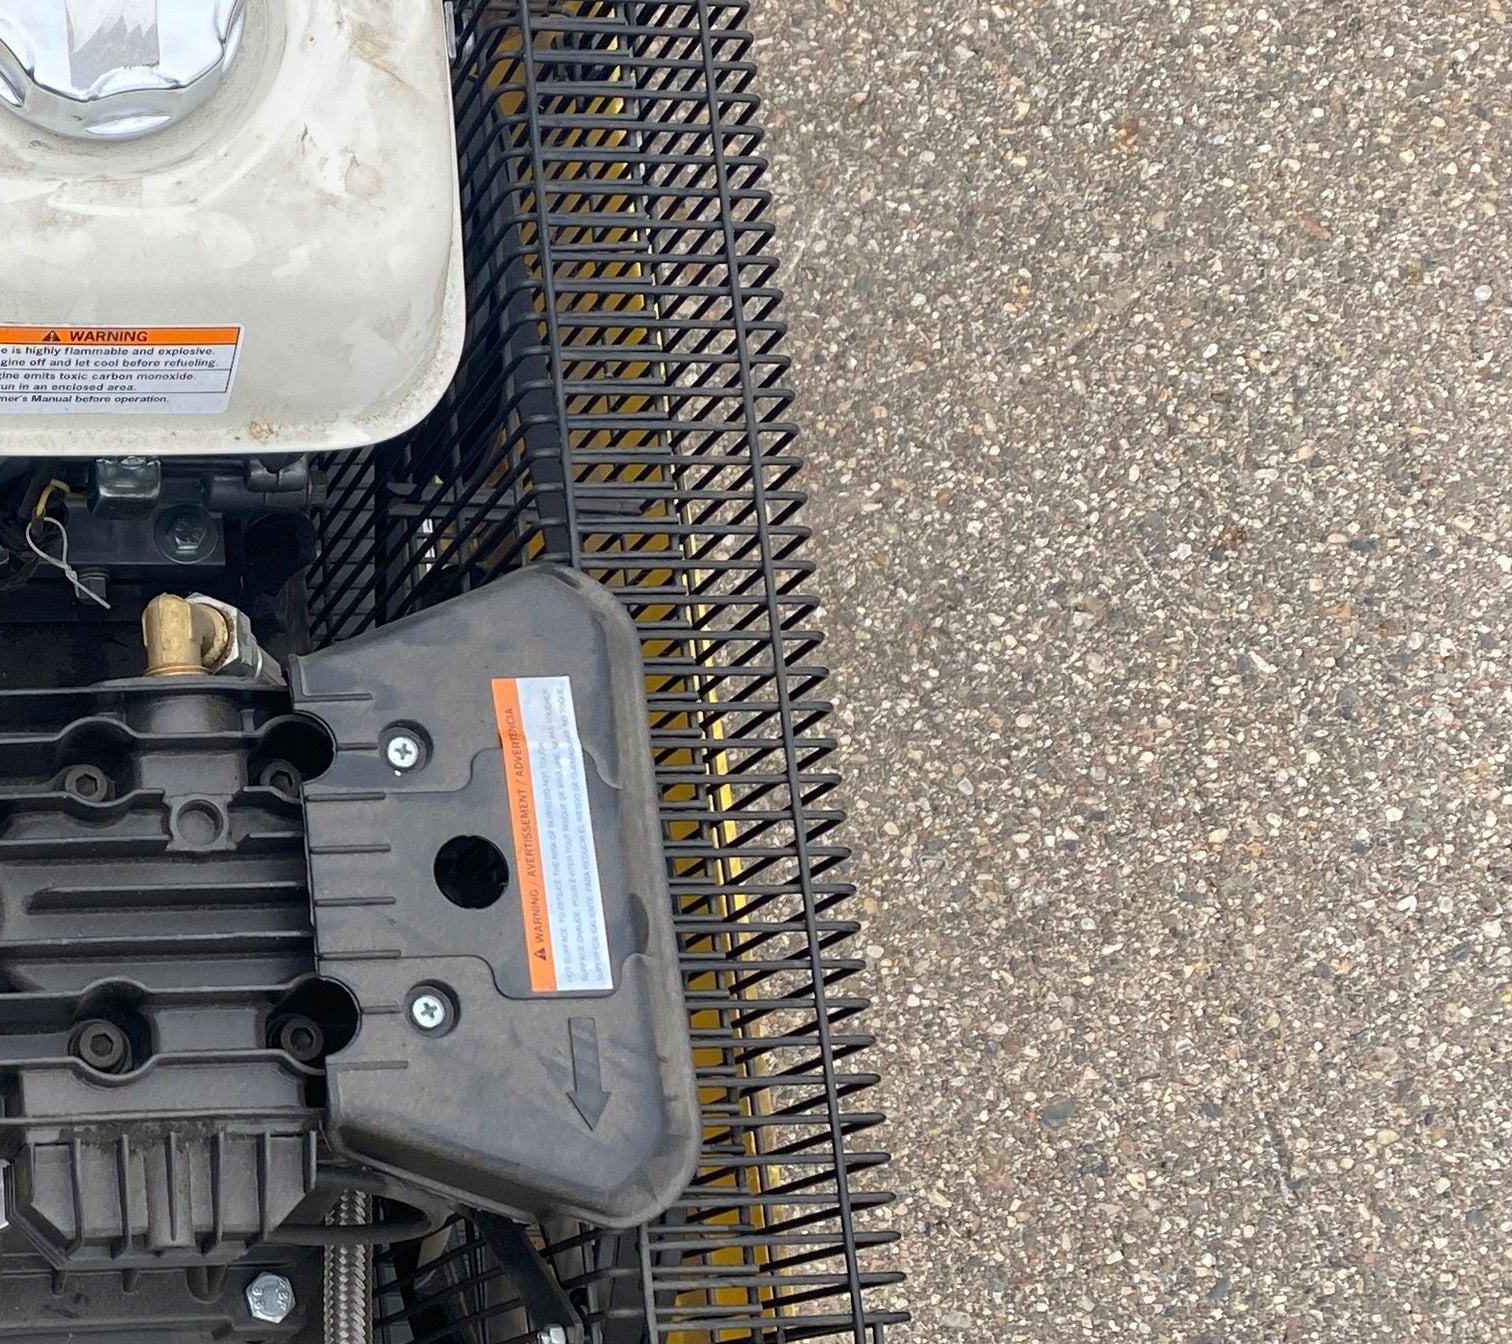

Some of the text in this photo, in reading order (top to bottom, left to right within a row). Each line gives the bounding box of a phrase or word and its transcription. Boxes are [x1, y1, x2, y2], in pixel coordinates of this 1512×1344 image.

[68, 331, 148, 342] WARNING
[11, 345, 21, 354] is
[24, 345, 59, 356] highly
[64, 345, 128, 355] flammable
[131, 346, 153, 355] and
[156, 346, 216, 357] explosive.
[29, 357, 48, 366] off
[49, 357, 71, 367] and
[74, 358, 92, 367] let
[95, 358, 119, 367] cool
[122, 358, 160, 368] before
[22, 371, 56, 380] emits
[58, 371, 87, 380] toxic
[90, 371, 132, 380] carbon
[17, 382, 30, 391] in
[33, 382, 48, 391] an
[51, 382, 103, 391] enclosed
[106, 383, 136, 392] area.
[31, 394, 72, 403] Manual
[74, 395, 111, 403] before
[113, 395, 169, 405] operation.
[505, 707, 523, 776] ADVERTENCIA
[518, 789, 537, 878] AVERTISSEMENT
[530, 889, 543, 944] WARNING
